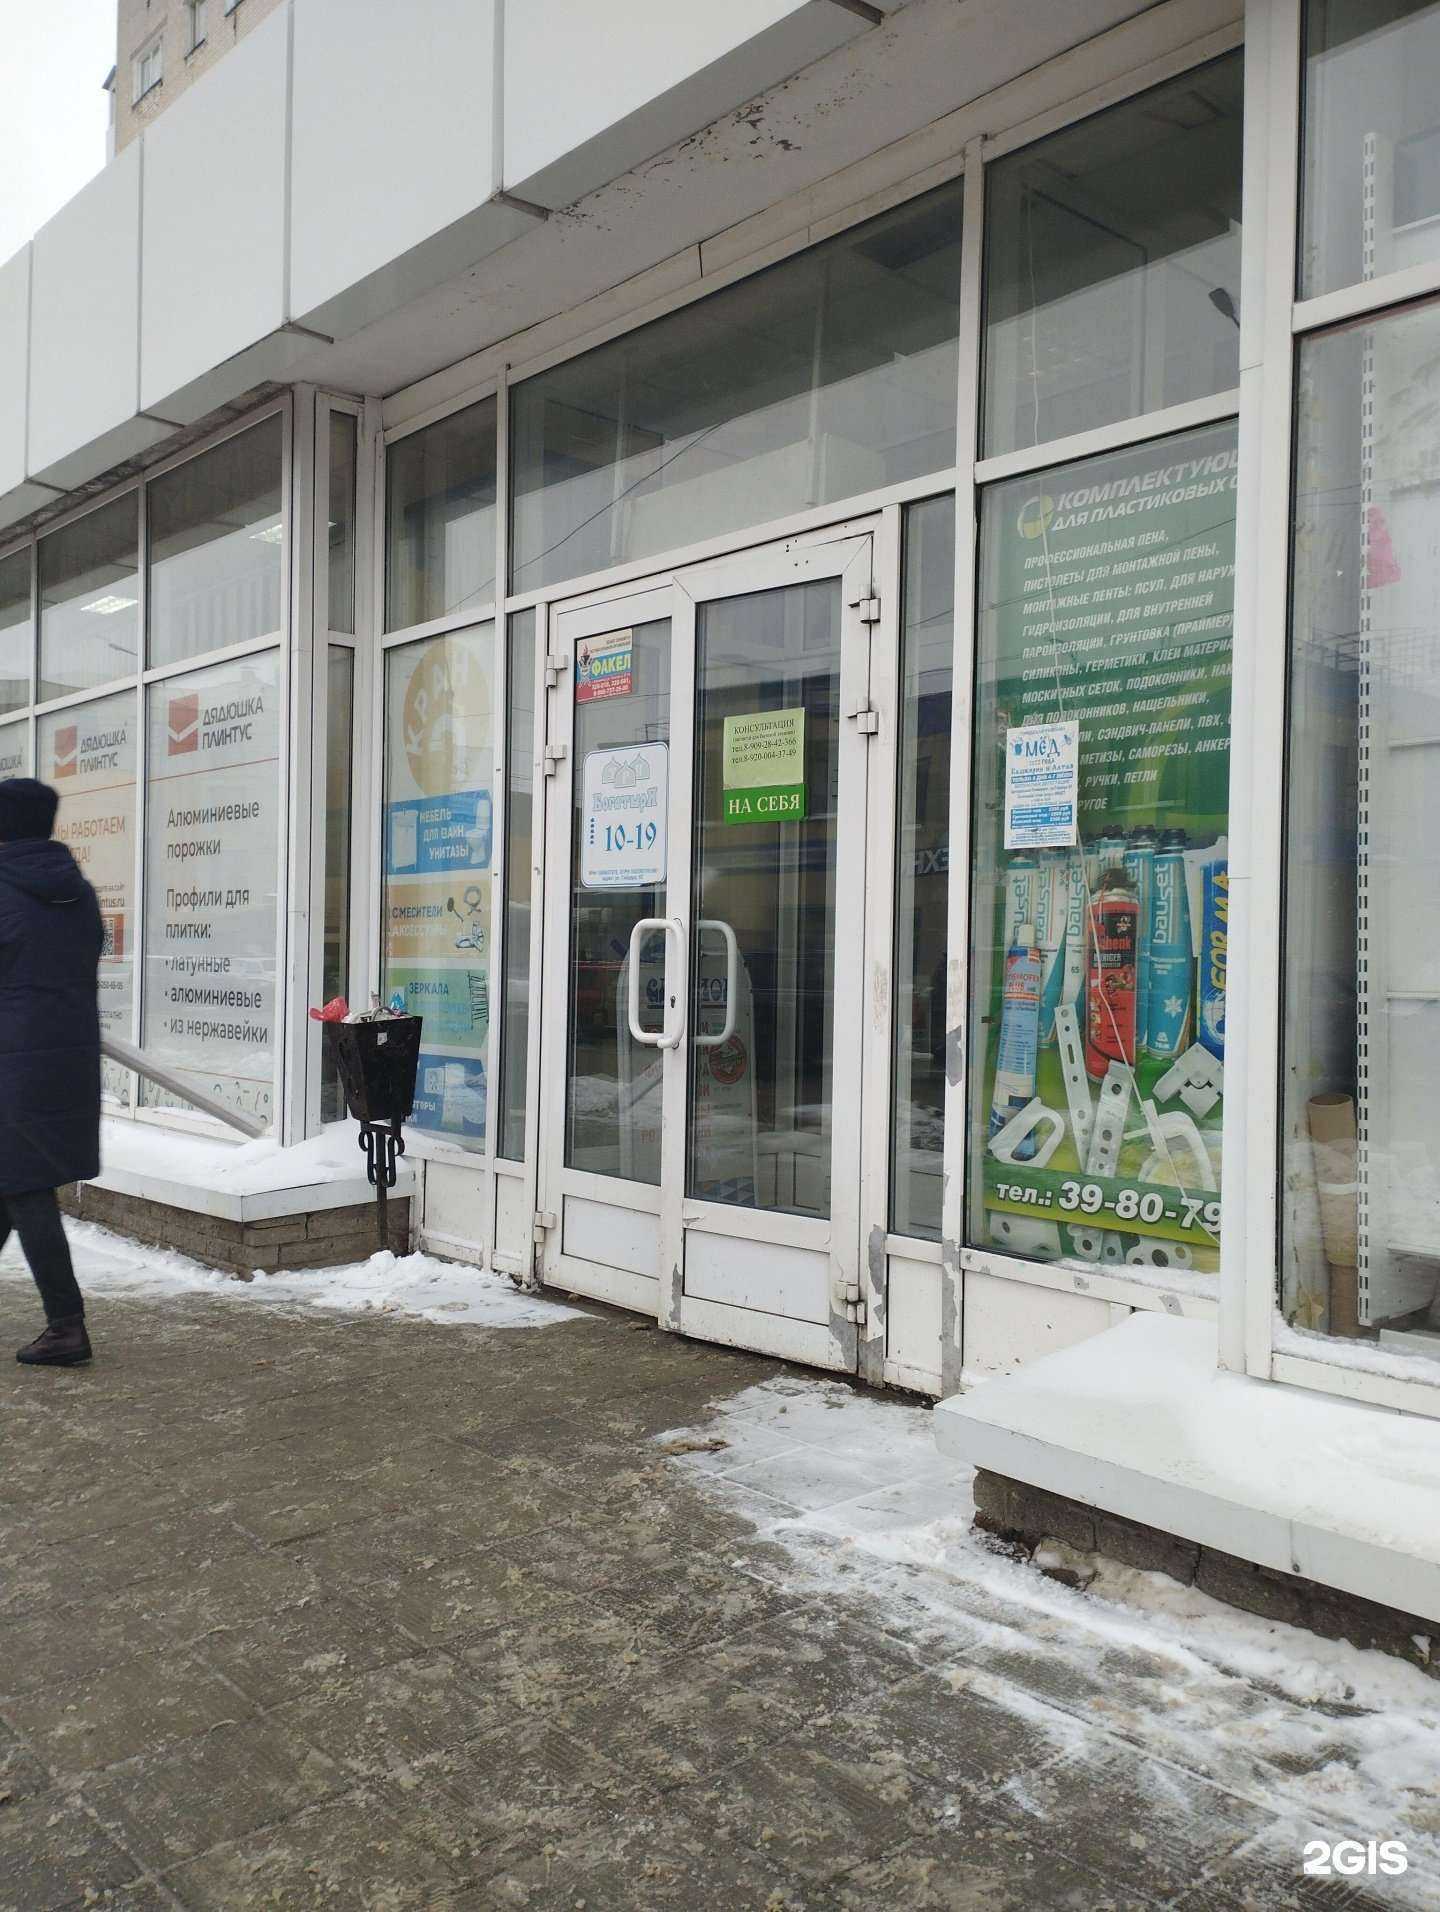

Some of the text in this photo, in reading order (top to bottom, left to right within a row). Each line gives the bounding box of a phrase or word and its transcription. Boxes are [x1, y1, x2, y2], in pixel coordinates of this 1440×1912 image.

[1052, 512, 1088, 531] ДЛЯ
[1091, 476, 1227, 521] ПЛАСТИКОВЫХ
[1024, 534, 1138, 569] ПРОФЕССИОНАЛЬНАЯ
[1024, 569, 1084, 592] ПИСТОЛЕТЫ
[1086, 566, 1110, 582] ДЛЯ
[1170, 573, 1196, 590] ДЛЯ
[1116, 607, 1141, 623] ДЛЯ
[1143, 592, 1214, 618] ВНУТРЕННЕЙ
[1110, 626, 1169, 646] ГРУНТОВКА
[591, 653, 632, 676] ФАКЕЛ
[202, 696, 264, 726] ДЯДЮШКА
[202, 723, 253, 750] ПЛИНТУС
[734, 719, 794, 735] КОНСУЛЬТАЦИЯ
[80, 728, 127, 753] ДЯДЮШКА
[1025, 735, 1060, 758] МЁД
[80, 758, 118, 775] ПЛИНТУС
[1123, 769, 1158, 784] ПЕТЛИ
[167, 801, 260, 829] Алюминиевые
[728, 794, 800, 815] НА СЕБЯ
[1078, 798, 1108, 811] РУГОЕ
[71, 816, 125, 839] РАБОТАЕМ
[605, 822, 657, 851] 10-19
[167, 839, 221, 862] порожки
[429, 844, 469, 860] УНИТАЗЫ
[166, 886, 250, 912] Профили для
[1067, 863, 1087, 936] bauset
[1152, 862, 1172, 944] bauset
[165, 922, 212, 940] плитки:
[170, 956, 231, 977] латунные
[170, 987, 262, 1009] алюминиевые
[409, 982, 449, 995] ЗЕРКАЛА
[170, 1017, 268, 1043] из нержавейки
[996, 1181, 1222, 1233] тел.: 39-80-79
